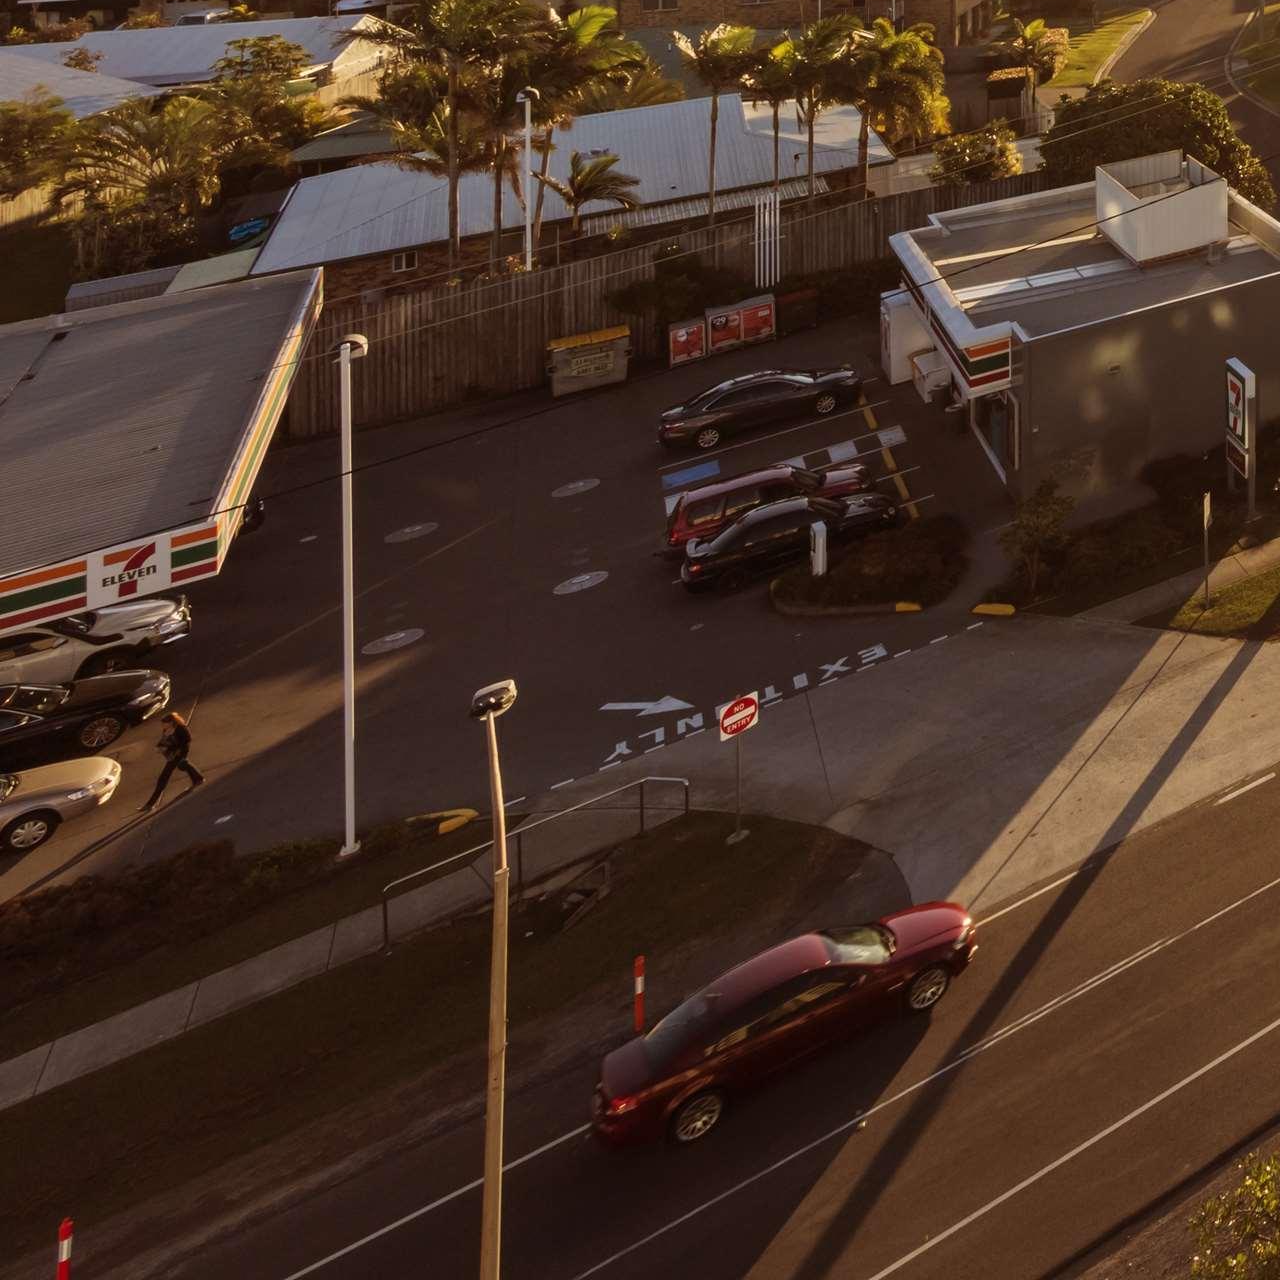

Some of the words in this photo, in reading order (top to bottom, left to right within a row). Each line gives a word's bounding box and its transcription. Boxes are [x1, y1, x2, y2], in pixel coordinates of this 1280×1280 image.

[760, 643, 888, 704] EXIT
[734, 703, 745, 713] NO
[727, 715, 751, 733] ENTRY
